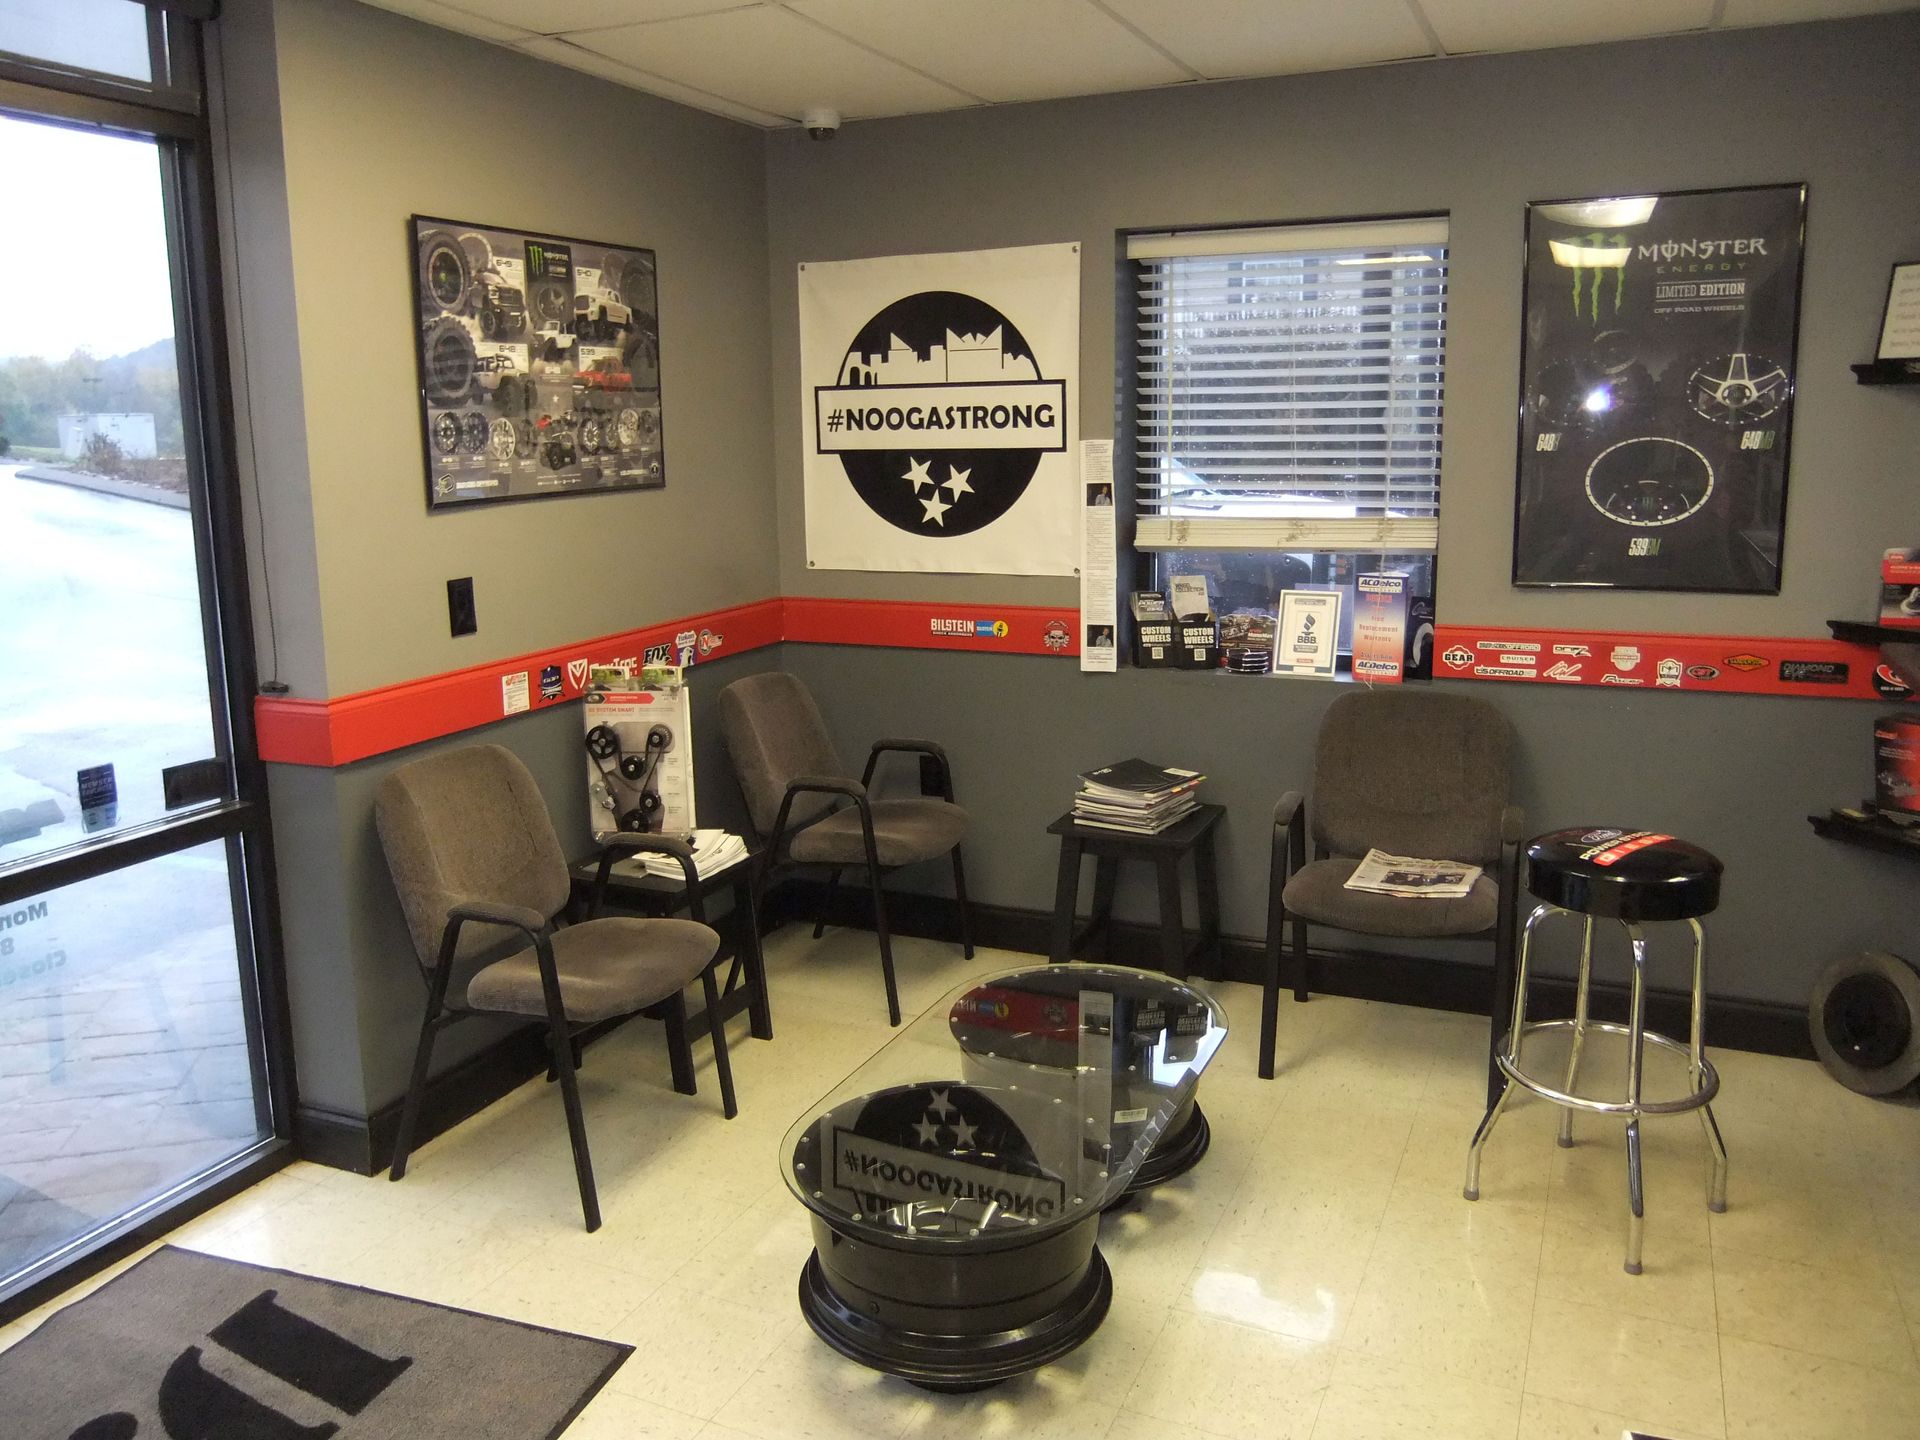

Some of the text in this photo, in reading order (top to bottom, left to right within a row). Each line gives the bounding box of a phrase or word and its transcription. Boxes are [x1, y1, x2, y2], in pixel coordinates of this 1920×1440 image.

[1637, 238, 1768, 262] MONSTER
[1656, 262, 1747, 275] ENERGY
[1656, 282, 1746, 299] LIMITED EDITION
[1654, 304, 1746, 315] OFF ROAD WHEELS
[827, 404, 1056, 433] #NOOGASTRONG
[1360, 578, 1402, 588] ACDelco
[930, 618, 975, 632] BILSTEIN
[1140, 626, 1172, 635] CUSTOM
[1183, 628, 1215, 636] CUSTOM
[1141, 634, 1172, 643] WHEELS
[1183, 636, 1215, 645] WHEELS
[1297, 635, 1317, 644] BBB
[644, 644, 672, 663] FOX
[1444, 653, 1474, 663] GEAR
[1357, 661, 1399, 671] ACDelco
